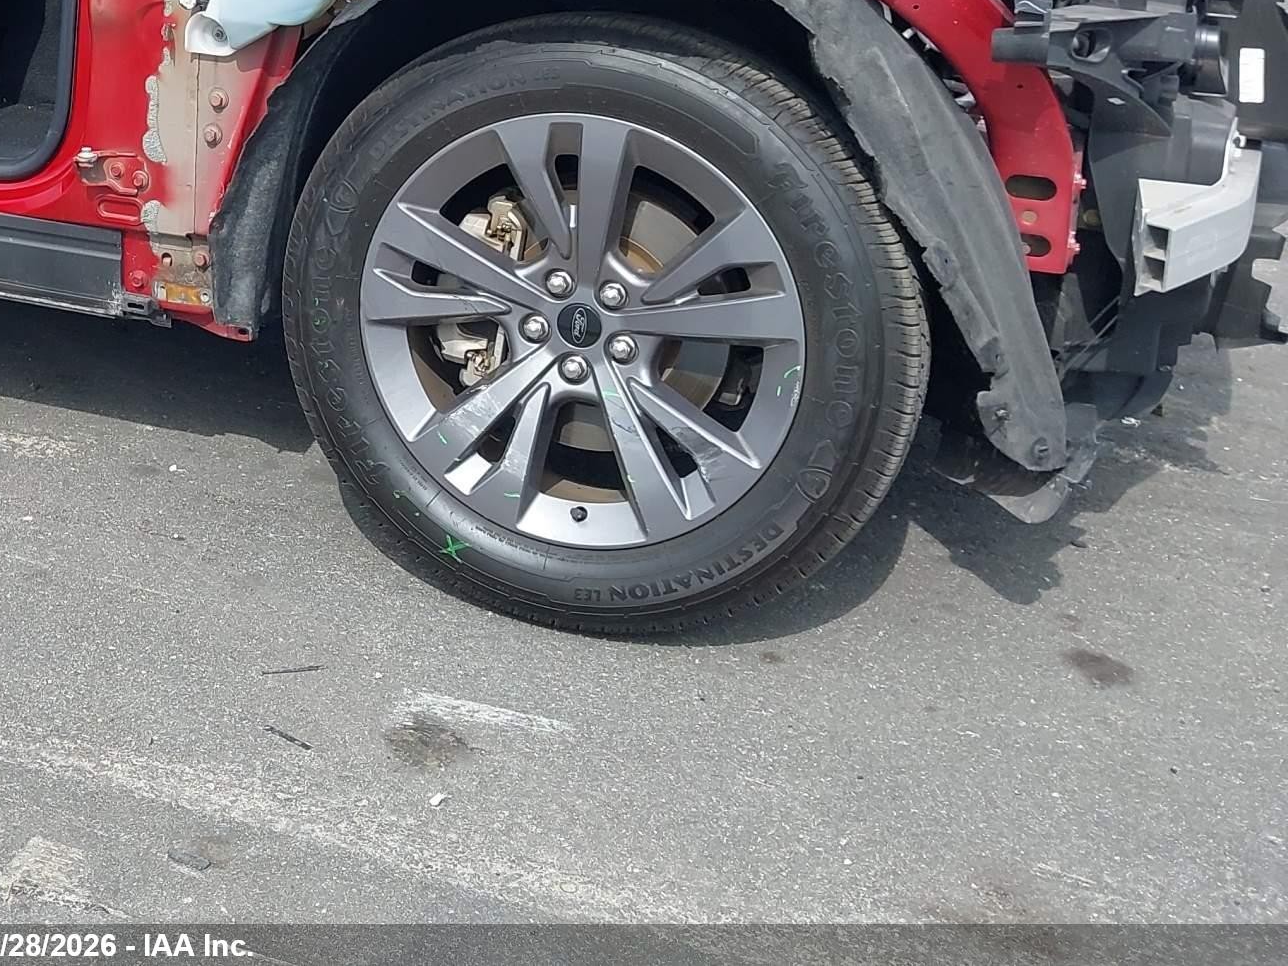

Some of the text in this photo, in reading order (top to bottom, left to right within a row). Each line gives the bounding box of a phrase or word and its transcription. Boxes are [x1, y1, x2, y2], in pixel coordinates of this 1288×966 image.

[573, 312, 586, 339] Ford
[609, 522, 785, 603] DESTINATION
[573, 586, 602, 603] LE3
